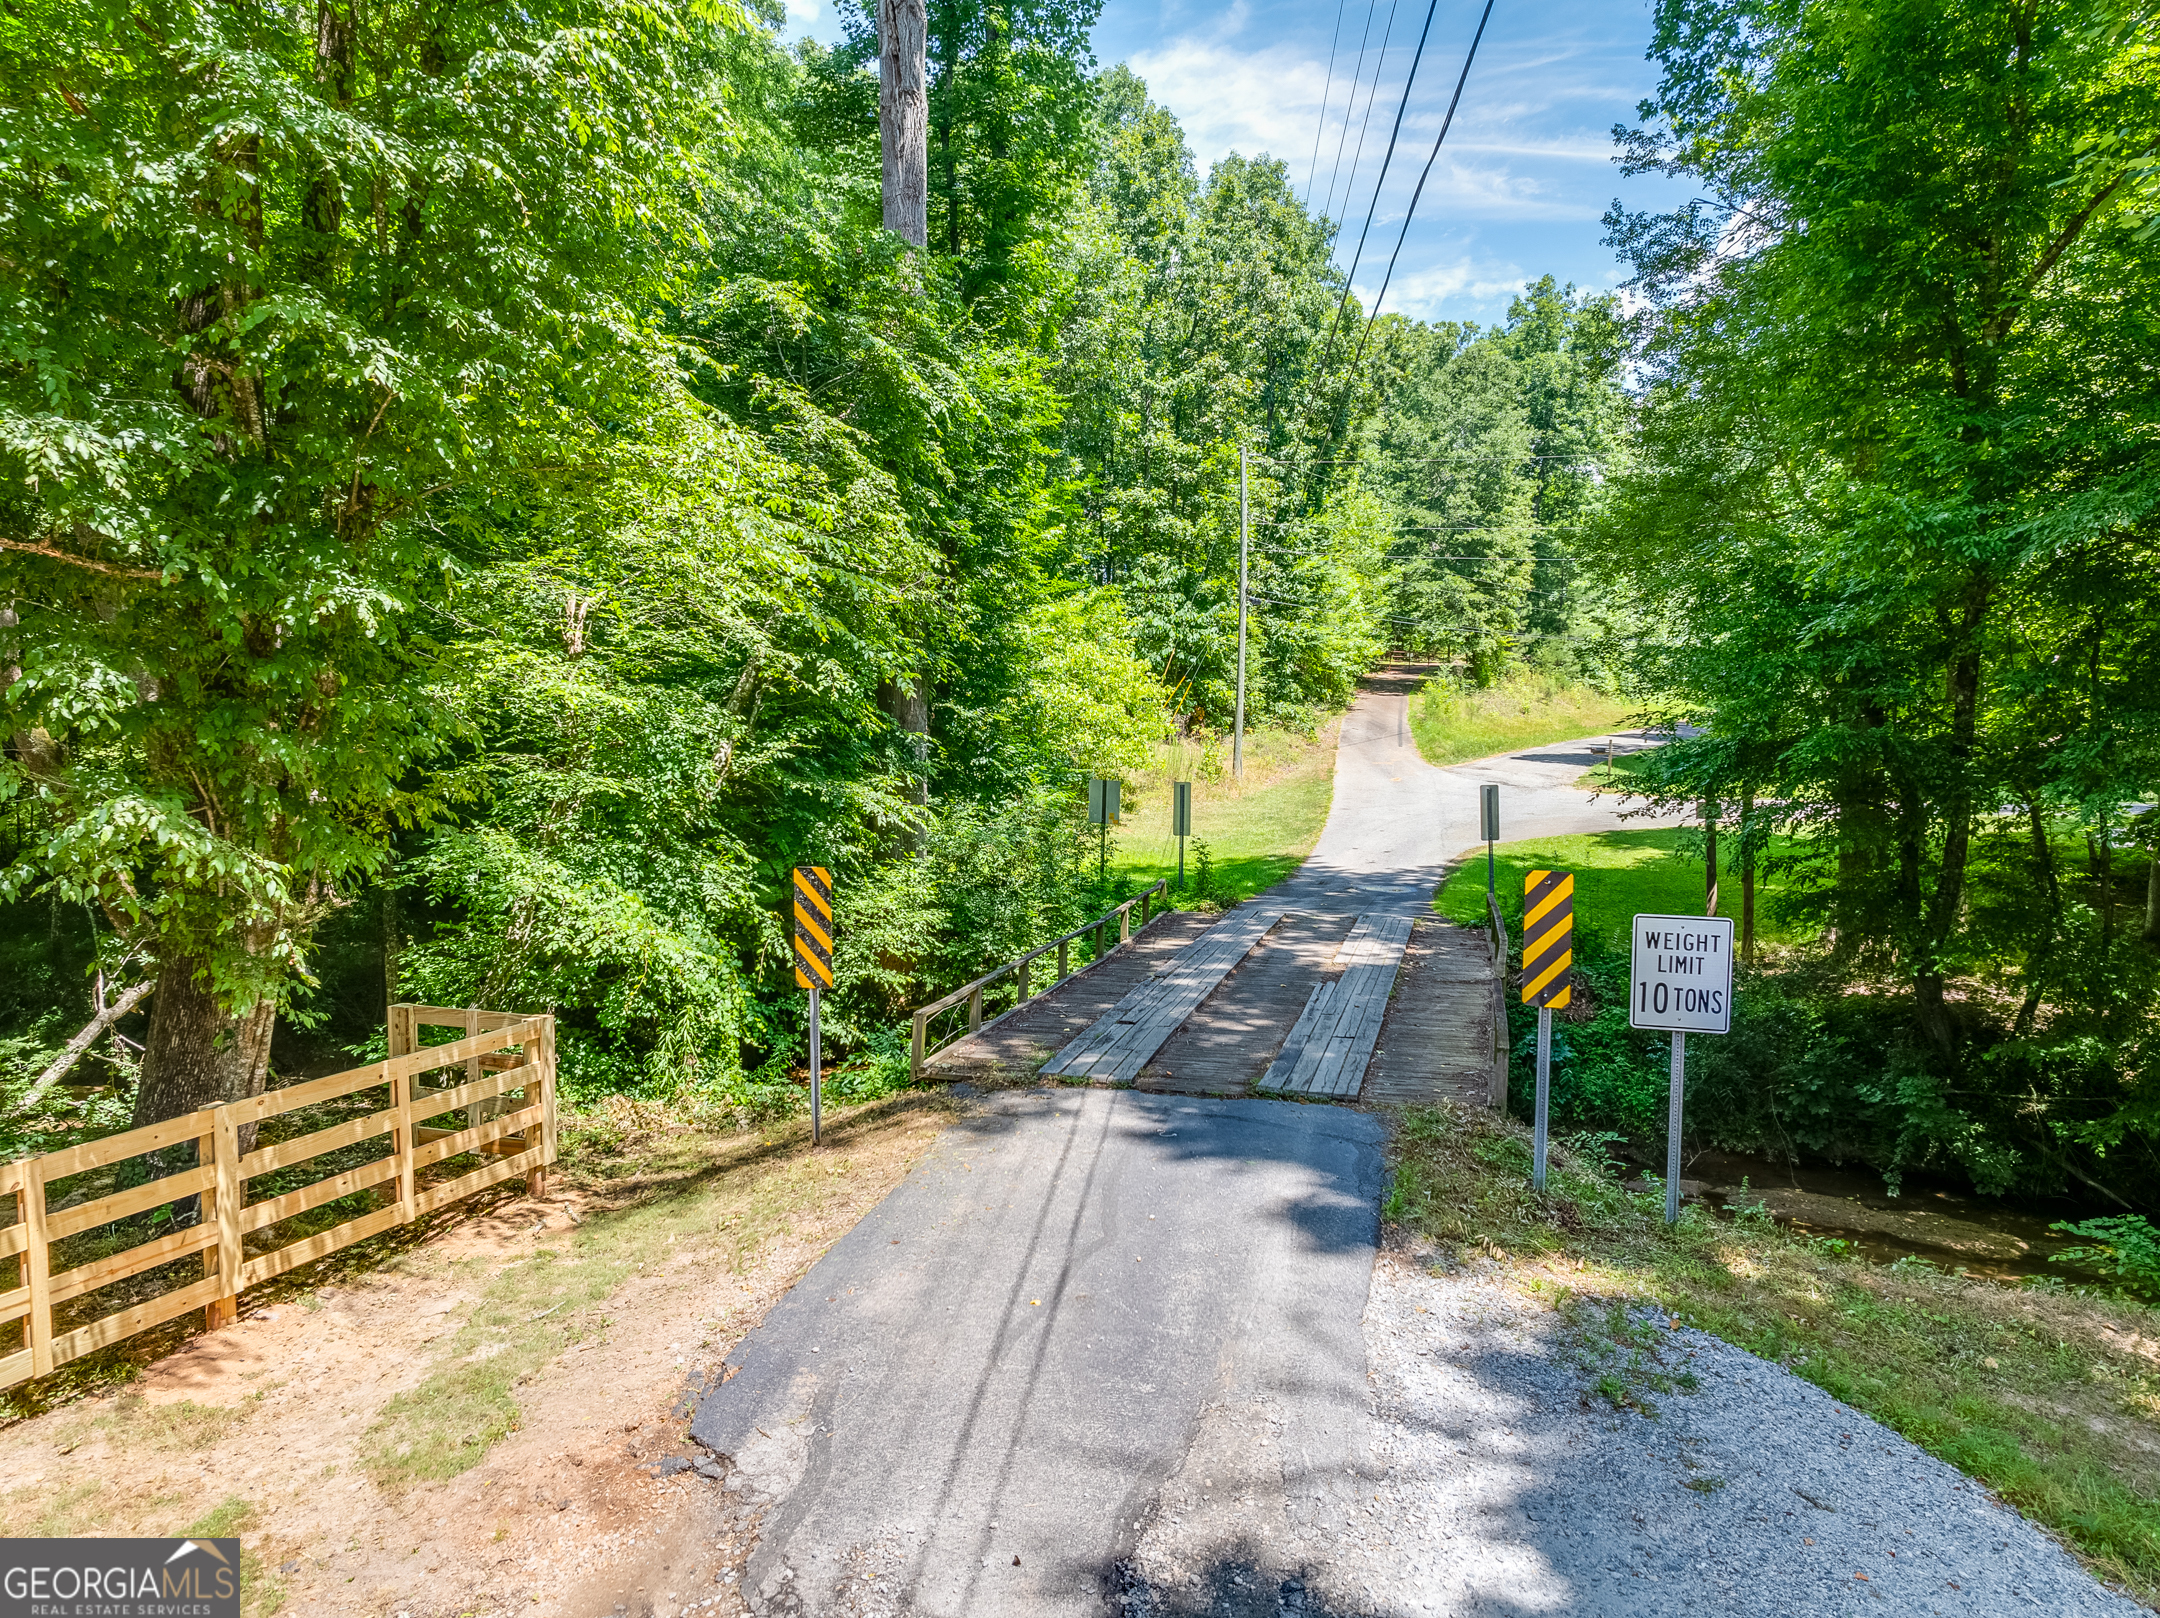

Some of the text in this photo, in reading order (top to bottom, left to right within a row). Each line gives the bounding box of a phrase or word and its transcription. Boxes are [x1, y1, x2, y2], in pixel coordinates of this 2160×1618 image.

[1645, 931, 1721, 952] WEIGHT
[1658, 954, 1705, 975] LIMIT
[1640, 981, 1723, 1015] 10 TONS
